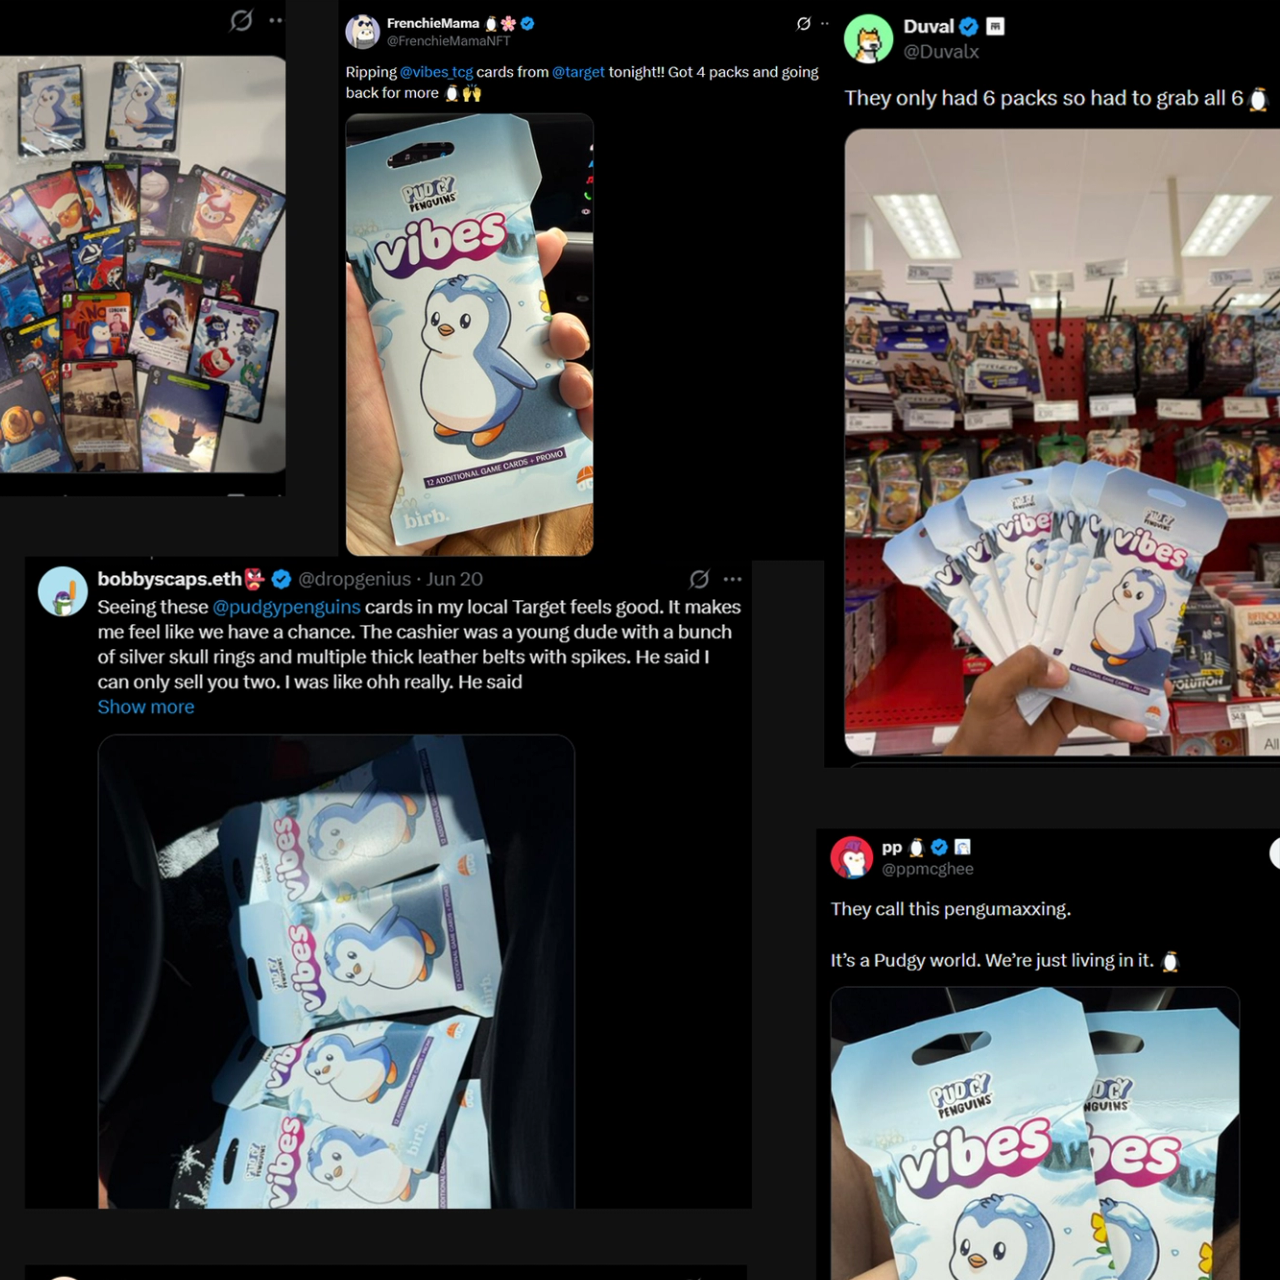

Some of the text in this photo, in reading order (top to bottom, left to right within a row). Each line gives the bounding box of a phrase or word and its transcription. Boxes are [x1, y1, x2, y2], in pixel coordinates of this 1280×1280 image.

[388, 18, 479, 28] FrenchieMama
[905, 18, 954, 33] Duval
[388, 35, 510, 46] @FrenchieMamaNFT
[375, 212, 508, 279] vibes
[436, 468, 480, 484] ADDITIONAL
[480, 463, 502, 476] GAME
[503, 459, 529, 472] CARDS
[536, 449, 564, 462] PROMO
[98, 571, 242, 590] bobbyscaps.eth
[99, 699, 194, 714] Show more
[831, 902, 1071, 919] They call this pengumaxxing.
[938, 1095, 993, 1119] PENGUINS
[900, 1117, 1052, 1199] vibes
